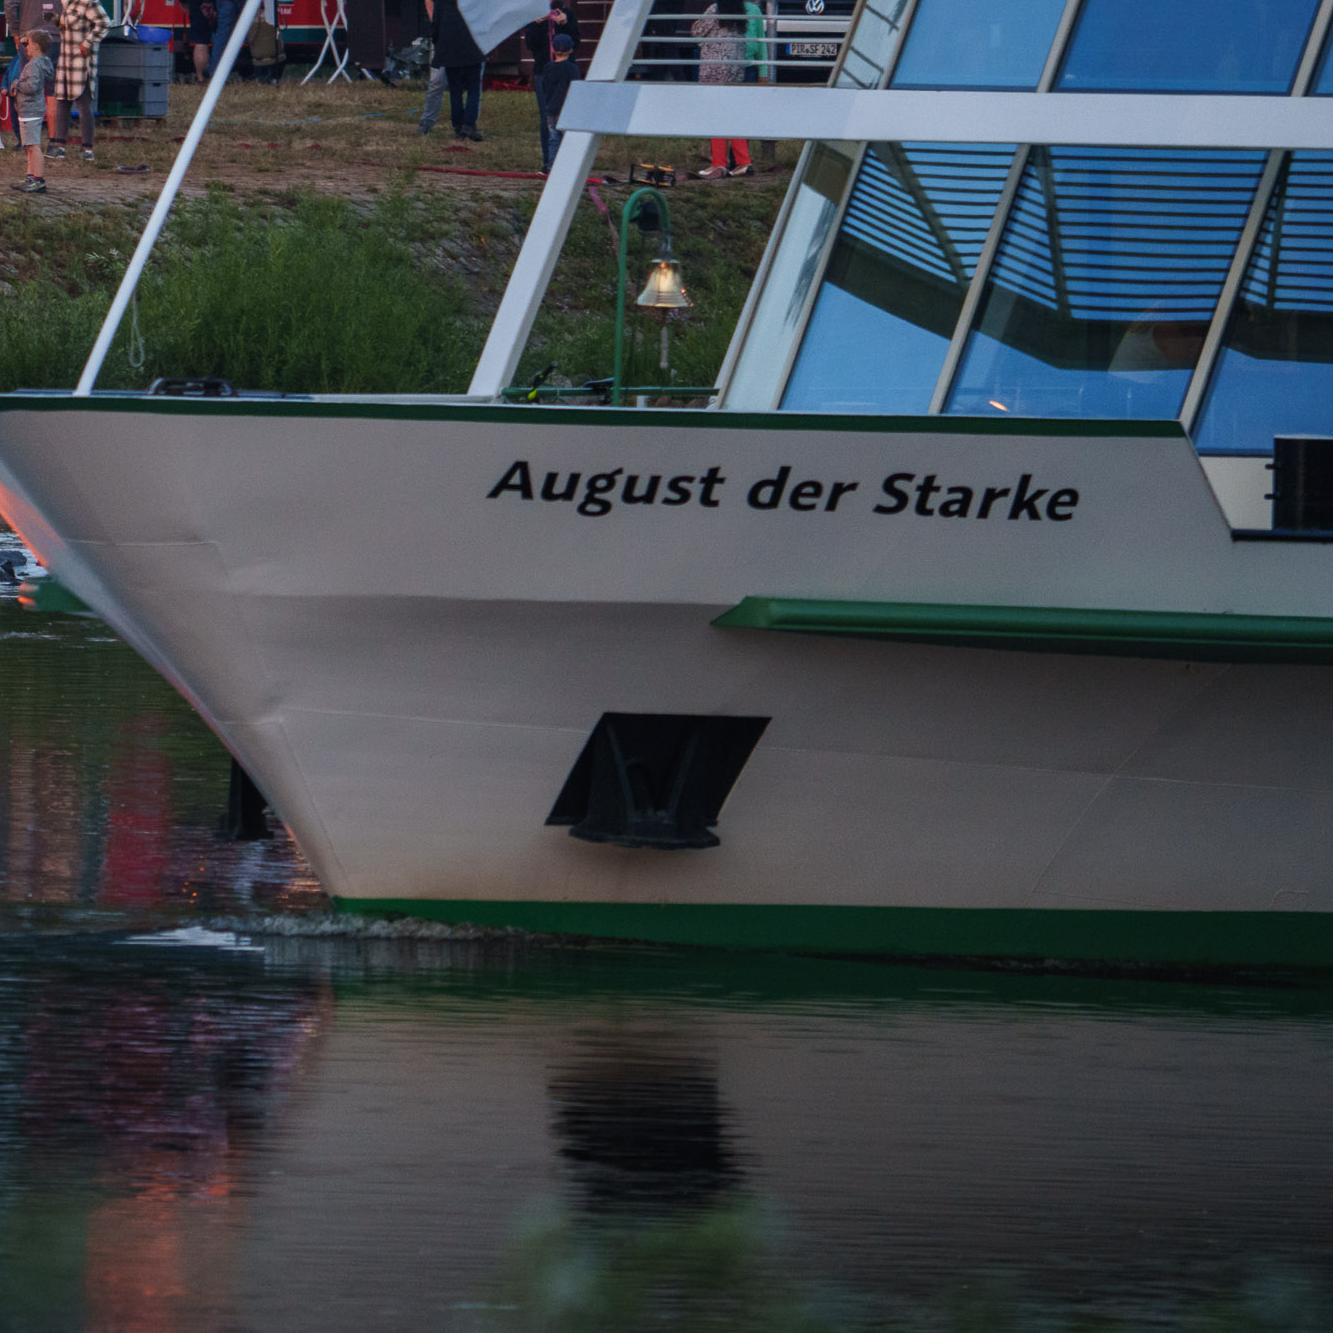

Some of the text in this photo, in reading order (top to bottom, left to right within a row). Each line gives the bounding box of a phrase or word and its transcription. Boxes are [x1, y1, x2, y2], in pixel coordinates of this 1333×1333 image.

[487, 461, 1081, 521] August der Starke
